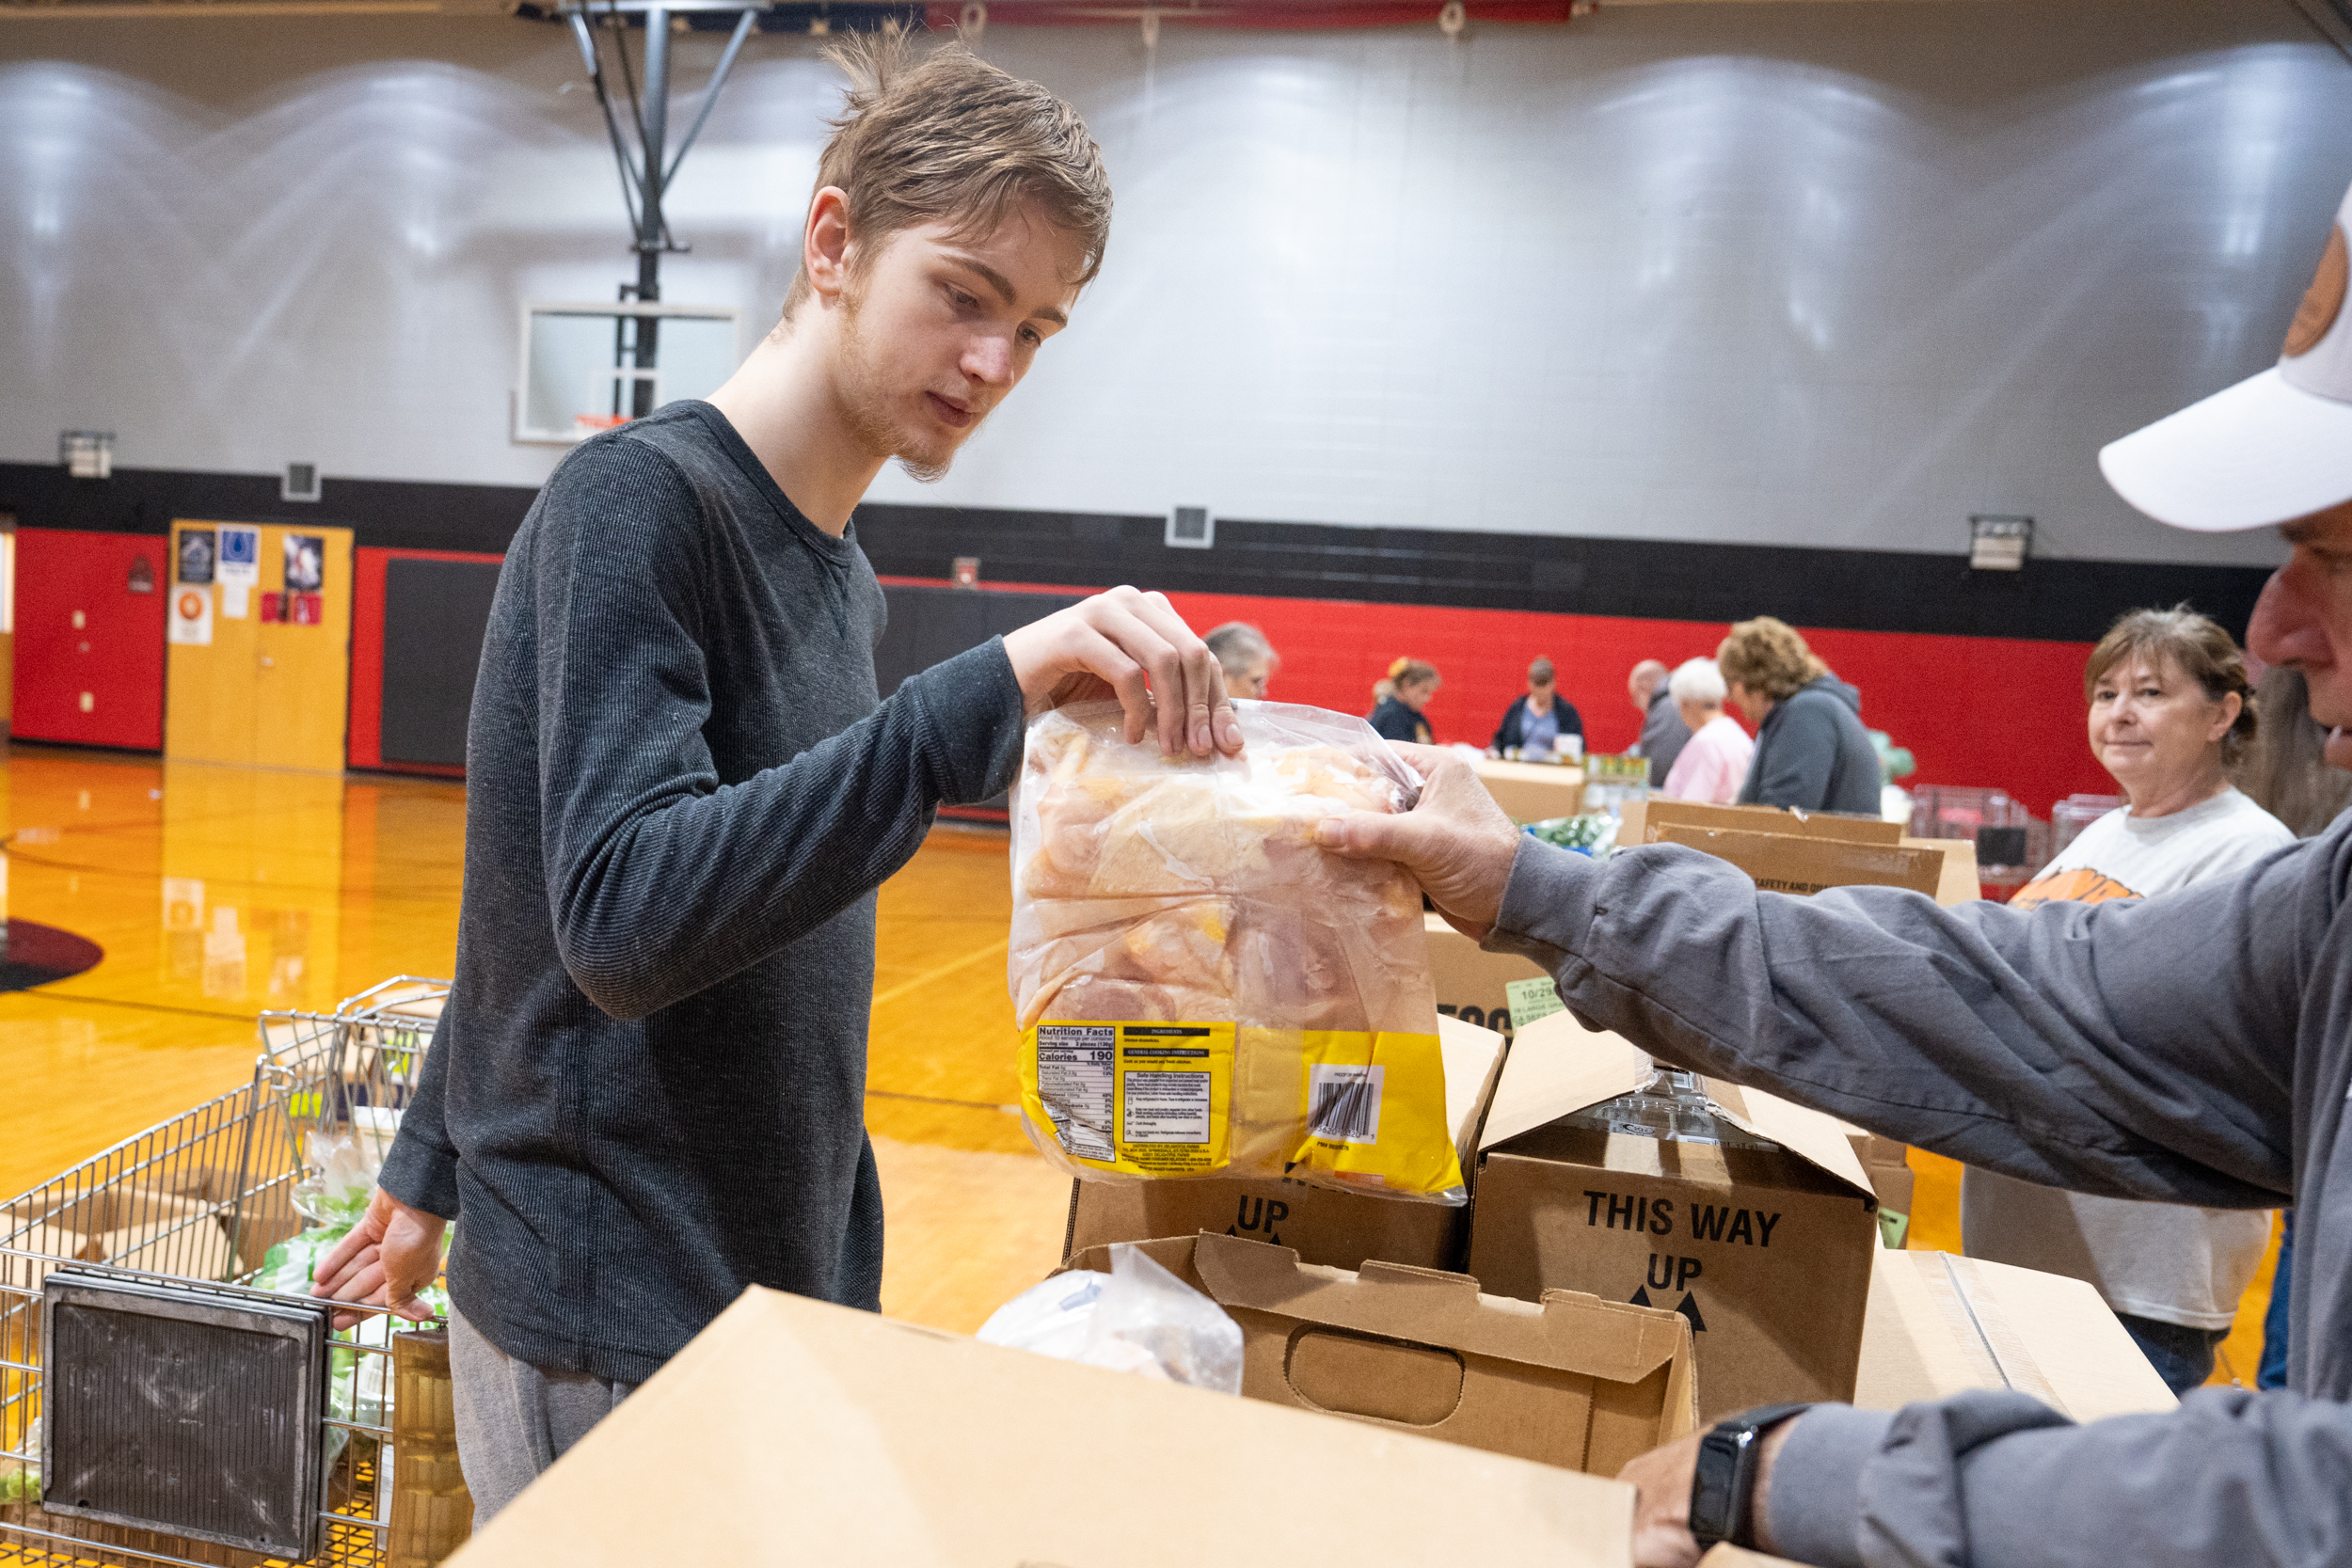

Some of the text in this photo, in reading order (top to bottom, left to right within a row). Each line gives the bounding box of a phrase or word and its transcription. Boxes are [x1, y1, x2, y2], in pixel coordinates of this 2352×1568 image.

[1788, 881, 1807, 892] AND
[1039, 1027, 1082, 1036] Nutrition
[1039, 1051, 1112, 1061] Calories 190
[1237, 1195, 1289, 1234] UP
[1583, 1190, 1782, 1247] THIS WAY
[1646, 1253, 1703, 1291] UP
